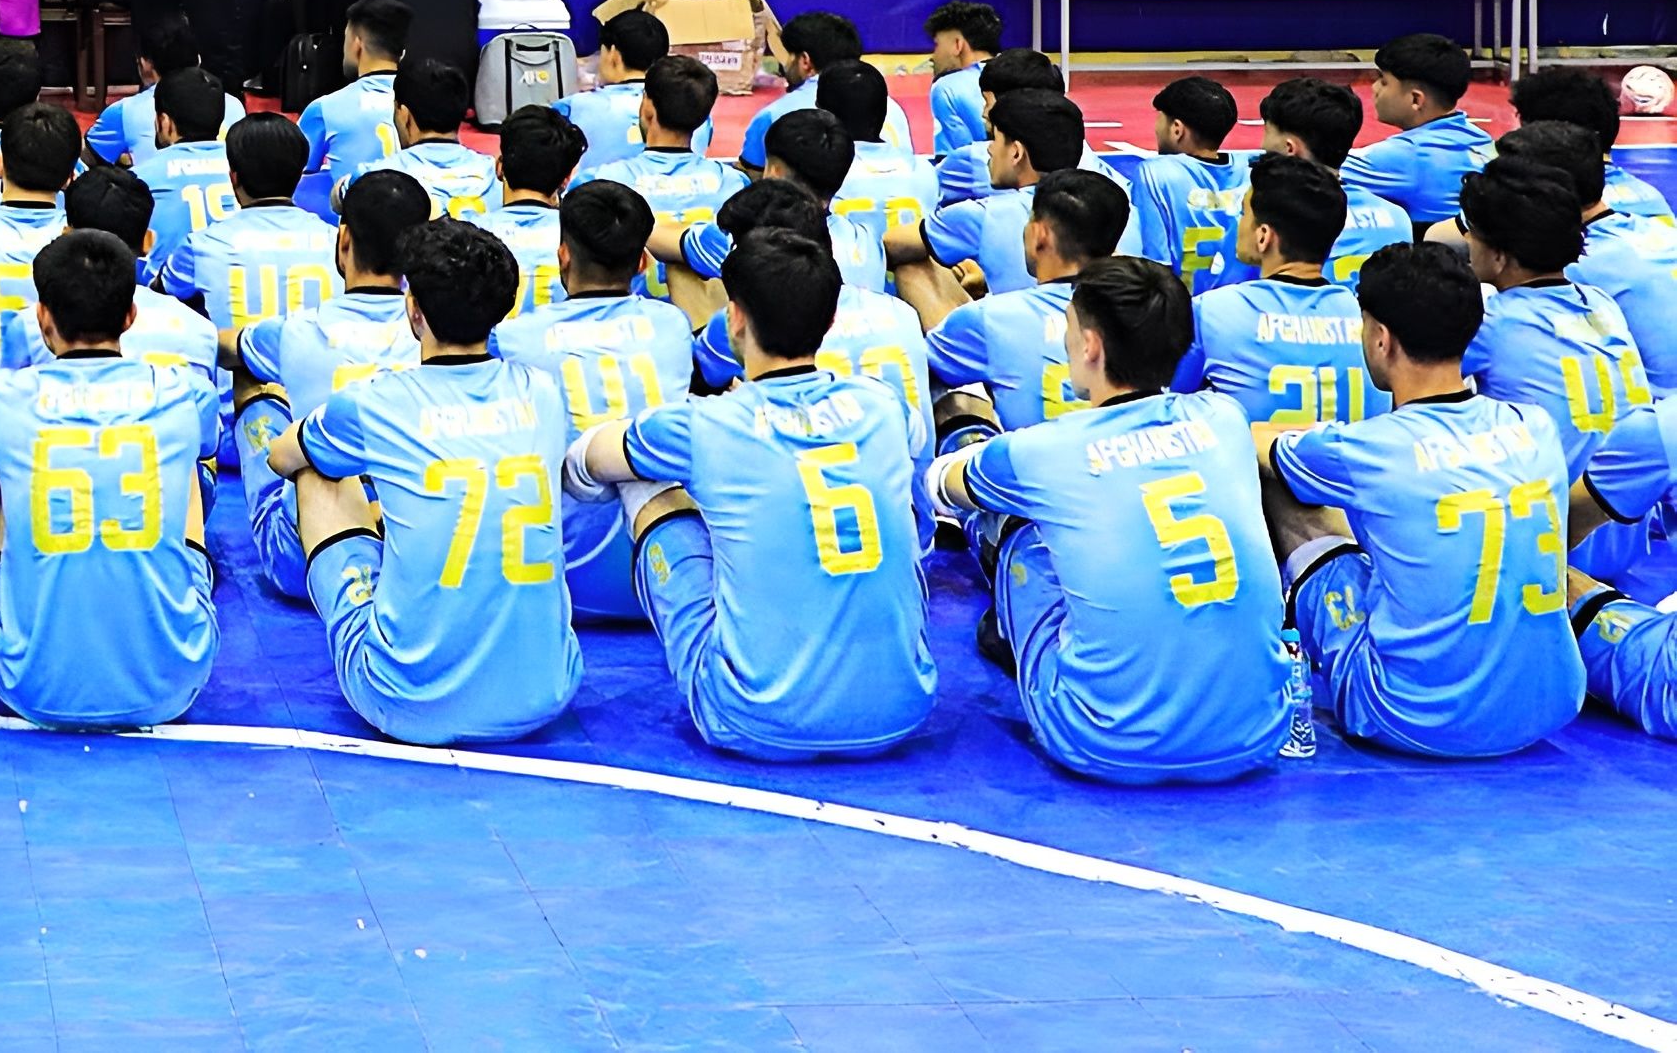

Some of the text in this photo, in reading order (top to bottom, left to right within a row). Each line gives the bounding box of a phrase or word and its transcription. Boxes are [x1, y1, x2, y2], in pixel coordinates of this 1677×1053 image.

[30, 423, 162, 555] 63
[424, 453, 556, 589] 72
[797, 442, 885, 577] 6
[1137, 470, 1241, 608] 5
[1435, 477, 1568, 626] 73
